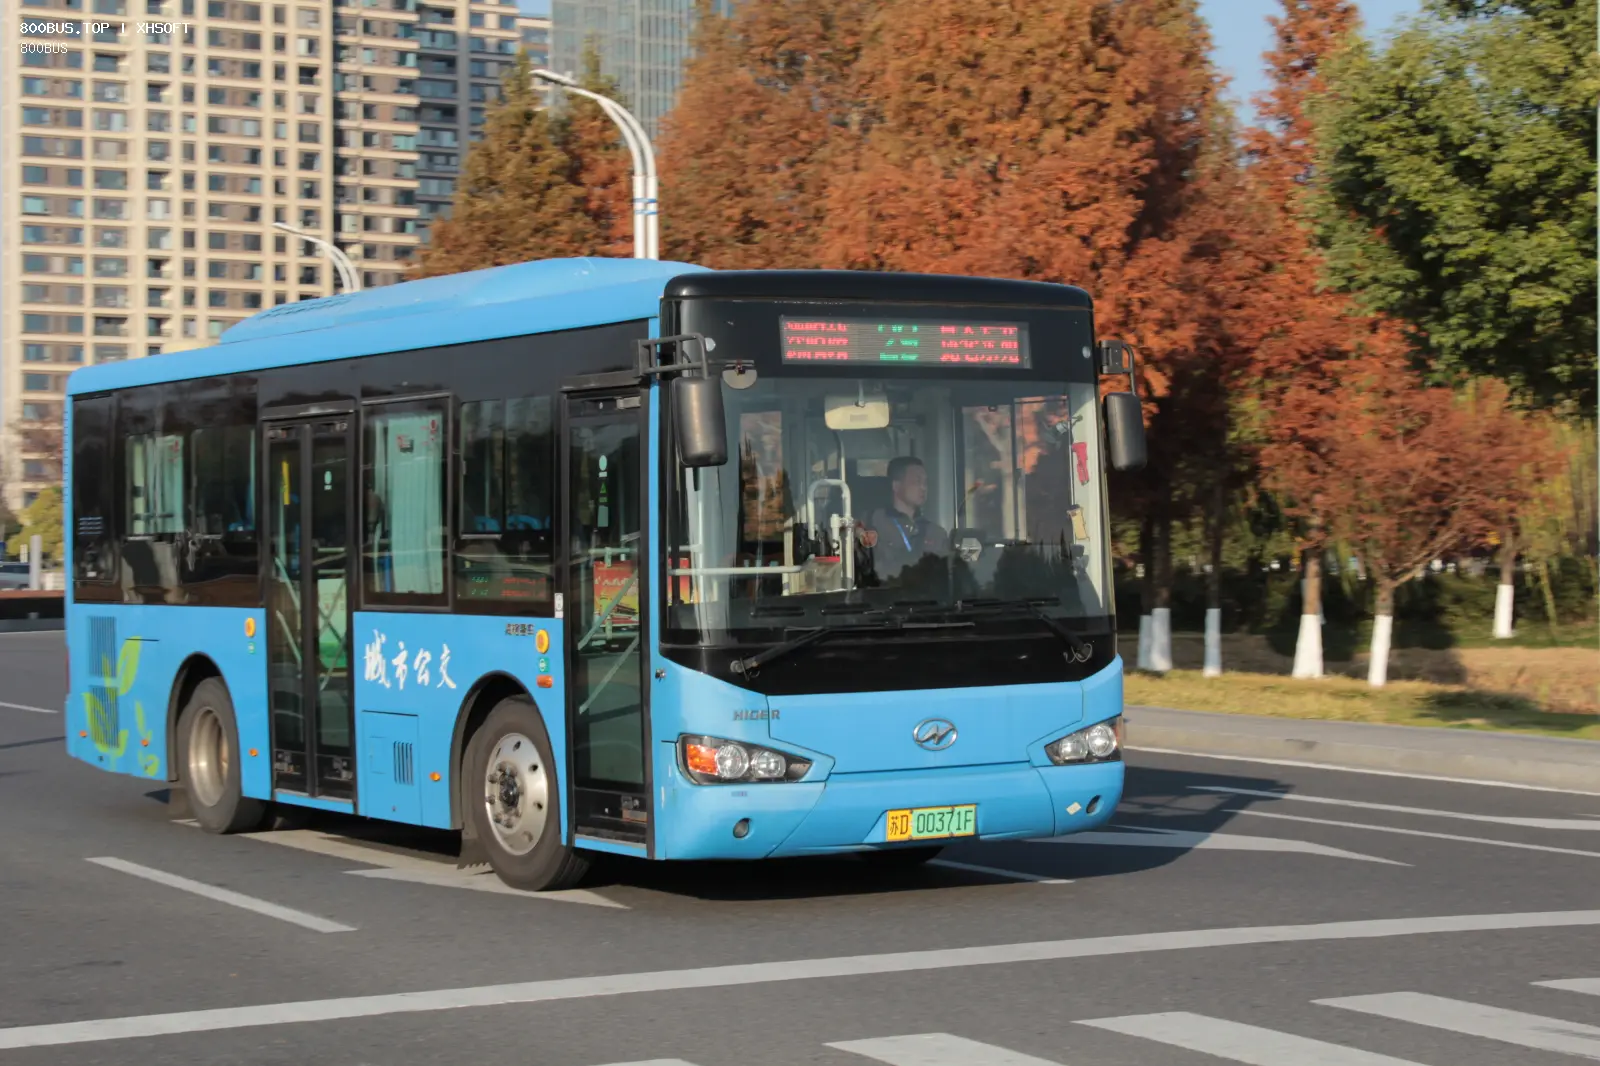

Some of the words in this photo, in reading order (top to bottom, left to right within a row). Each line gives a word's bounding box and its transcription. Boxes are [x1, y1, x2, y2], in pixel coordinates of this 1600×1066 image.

[363, 628, 457, 691] 城市公交
[732, 709, 780, 721] HIGER
